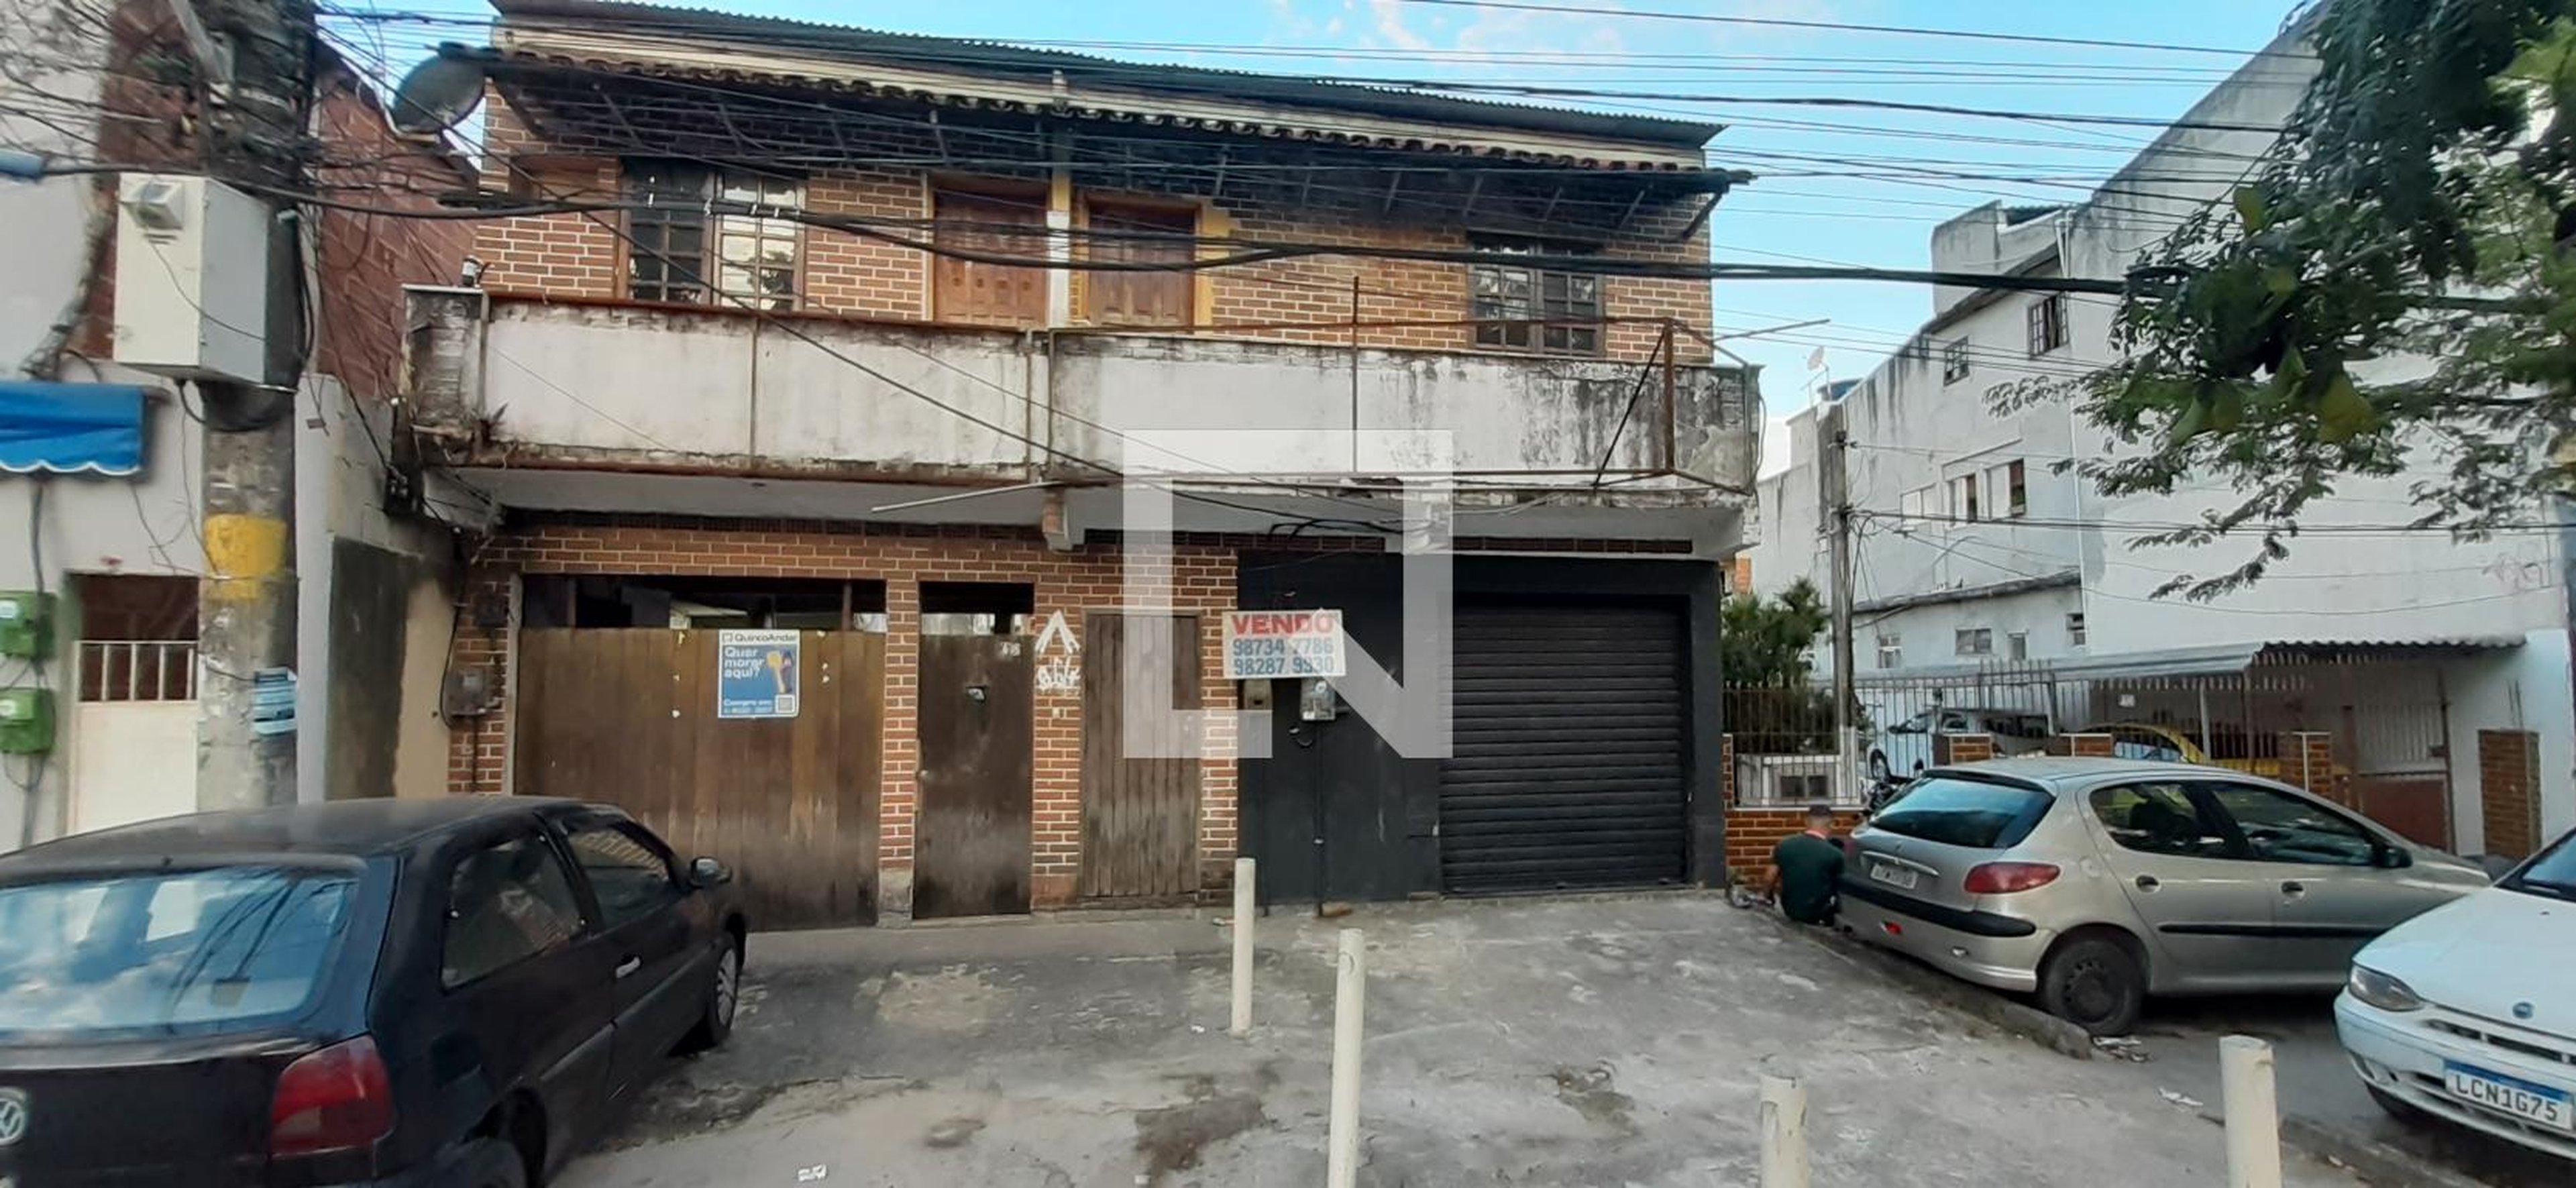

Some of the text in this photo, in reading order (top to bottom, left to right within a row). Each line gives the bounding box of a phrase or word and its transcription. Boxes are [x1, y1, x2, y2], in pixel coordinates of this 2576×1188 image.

[1231, 613, 1334, 635] VENDO
[724, 647, 758, 658] Quer
[1232, 638, 1285, 657] 98734
[1234, 657, 1285, 676] 98287
[2456, 1075, 2558, 1122] LCN1G75
